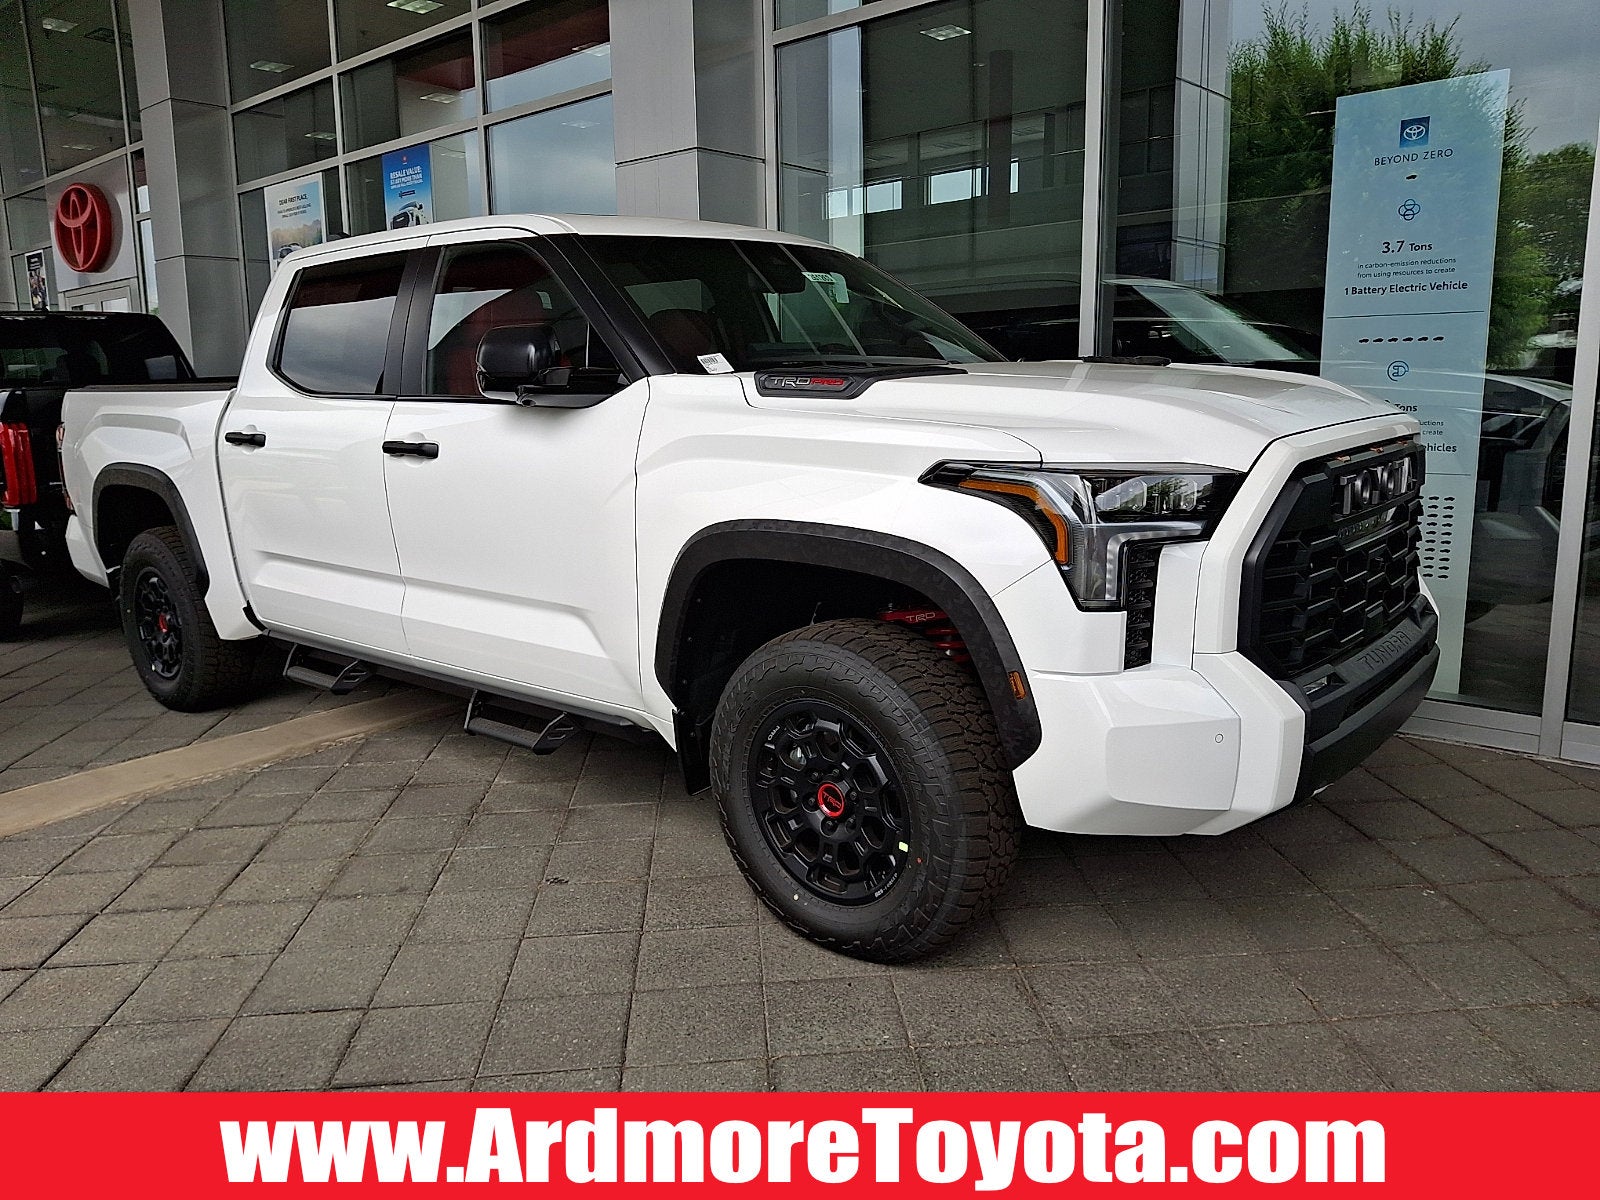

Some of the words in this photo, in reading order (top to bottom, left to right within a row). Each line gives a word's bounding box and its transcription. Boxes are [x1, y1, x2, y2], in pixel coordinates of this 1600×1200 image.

[1374, 153, 1419, 166] BEYOND
[1422, 148, 1454, 160] ZERO
[1381, 240, 1405, 254] 3.7
[1408, 242, 1433, 252] Tons
[1364, 259, 1419, 269] carbon-emission
[1420, 257, 1457, 266] reductions
[1373, 270, 1391, 279] using
[1392, 268, 1424, 276] resources
[1434, 266, 1456, 274] create
[1344, 287, 1349, 296] 1
[1351, 283, 1388, 296] Battery
[1389, 282, 1427, 293] Electric
[1429, 280, 1468, 291] Vehicle
[769, 376, 811, 388] TRD
[1339, 456, 1417, 516] TOYOTA
[905, 611, 936, 623] TRD
[1358, 630, 1412, 671] TUNDRA
